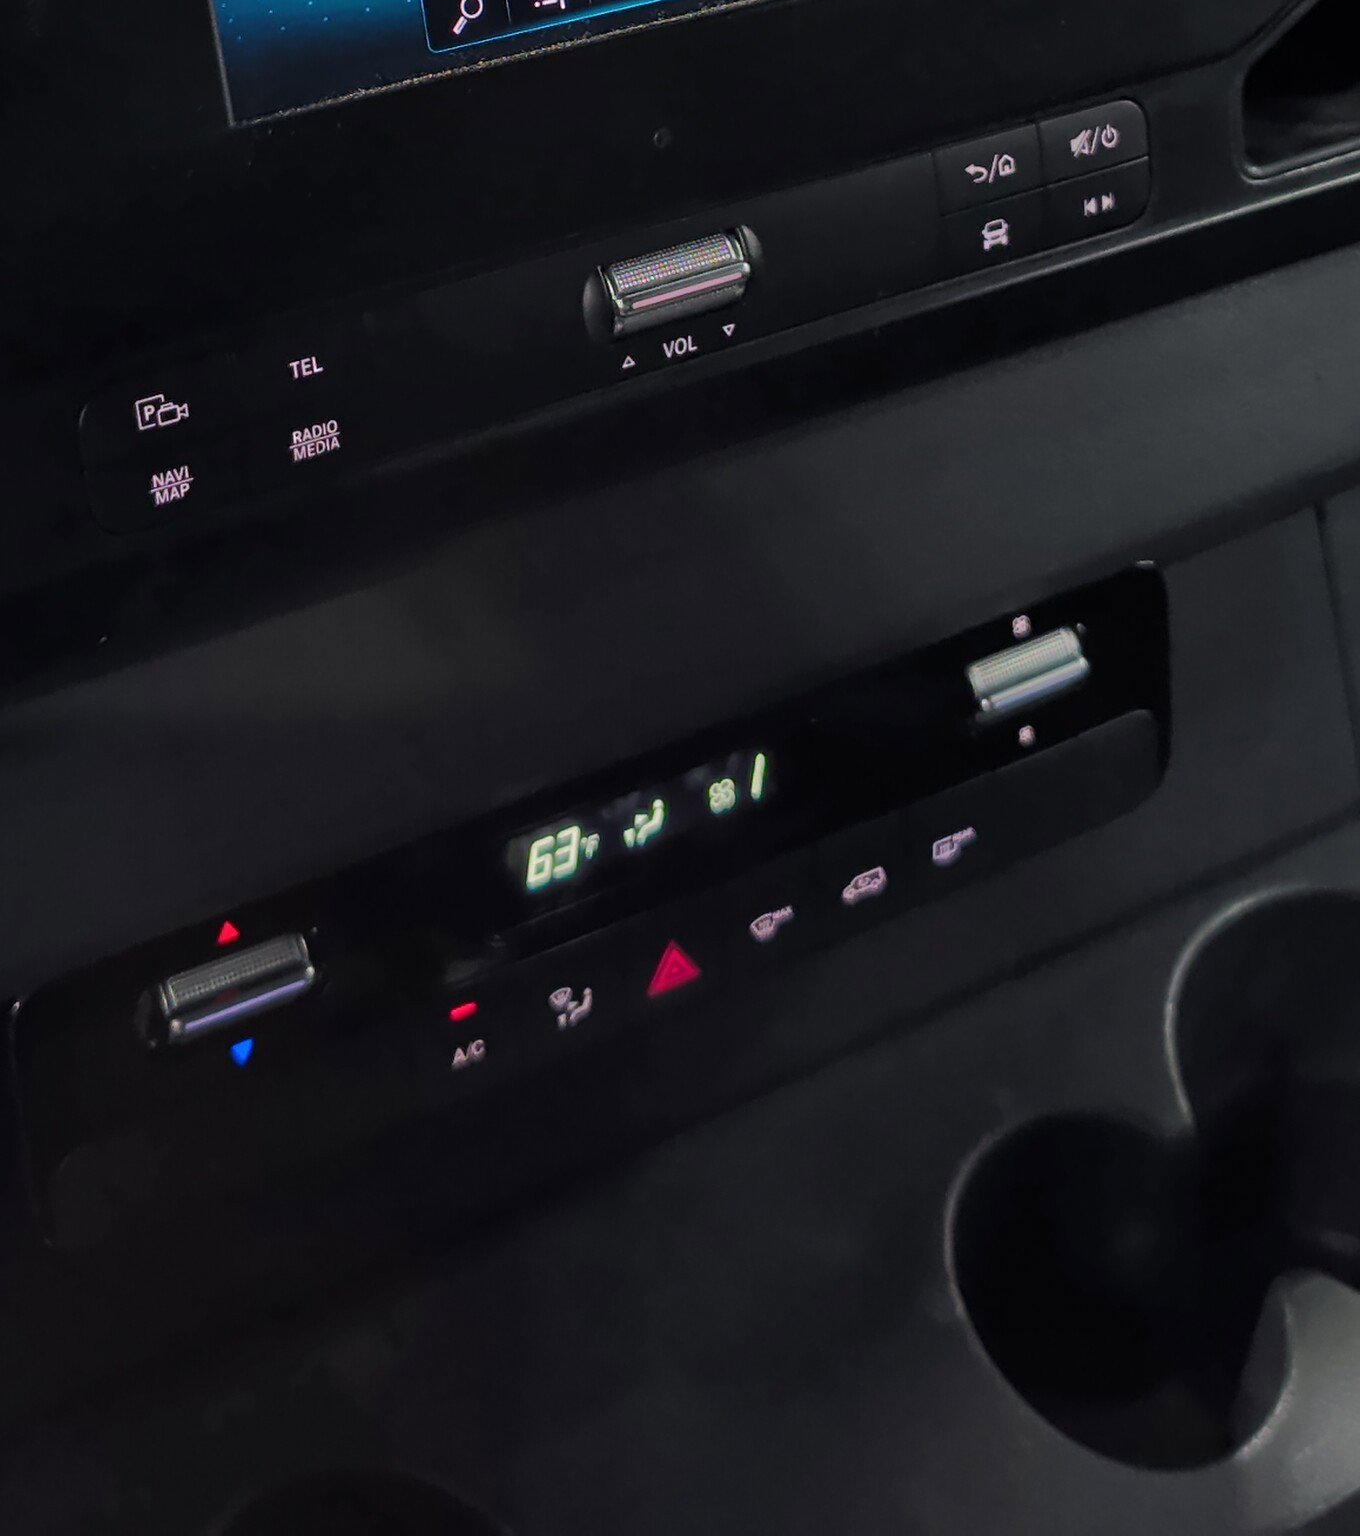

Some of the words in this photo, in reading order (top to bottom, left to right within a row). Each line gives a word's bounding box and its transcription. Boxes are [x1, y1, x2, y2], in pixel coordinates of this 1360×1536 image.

[663, 335, 698, 359] VOL
[289, 356, 324, 381] TEL
[292, 420, 339, 445] RADIO
[293, 436, 341, 463] MEDIA
[151, 465, 190, 489] NAVI
[154, 483, 191, 507] MAP
[751, 752, 766, 800] 1
[452, 1039, 486, 1068] A/C
